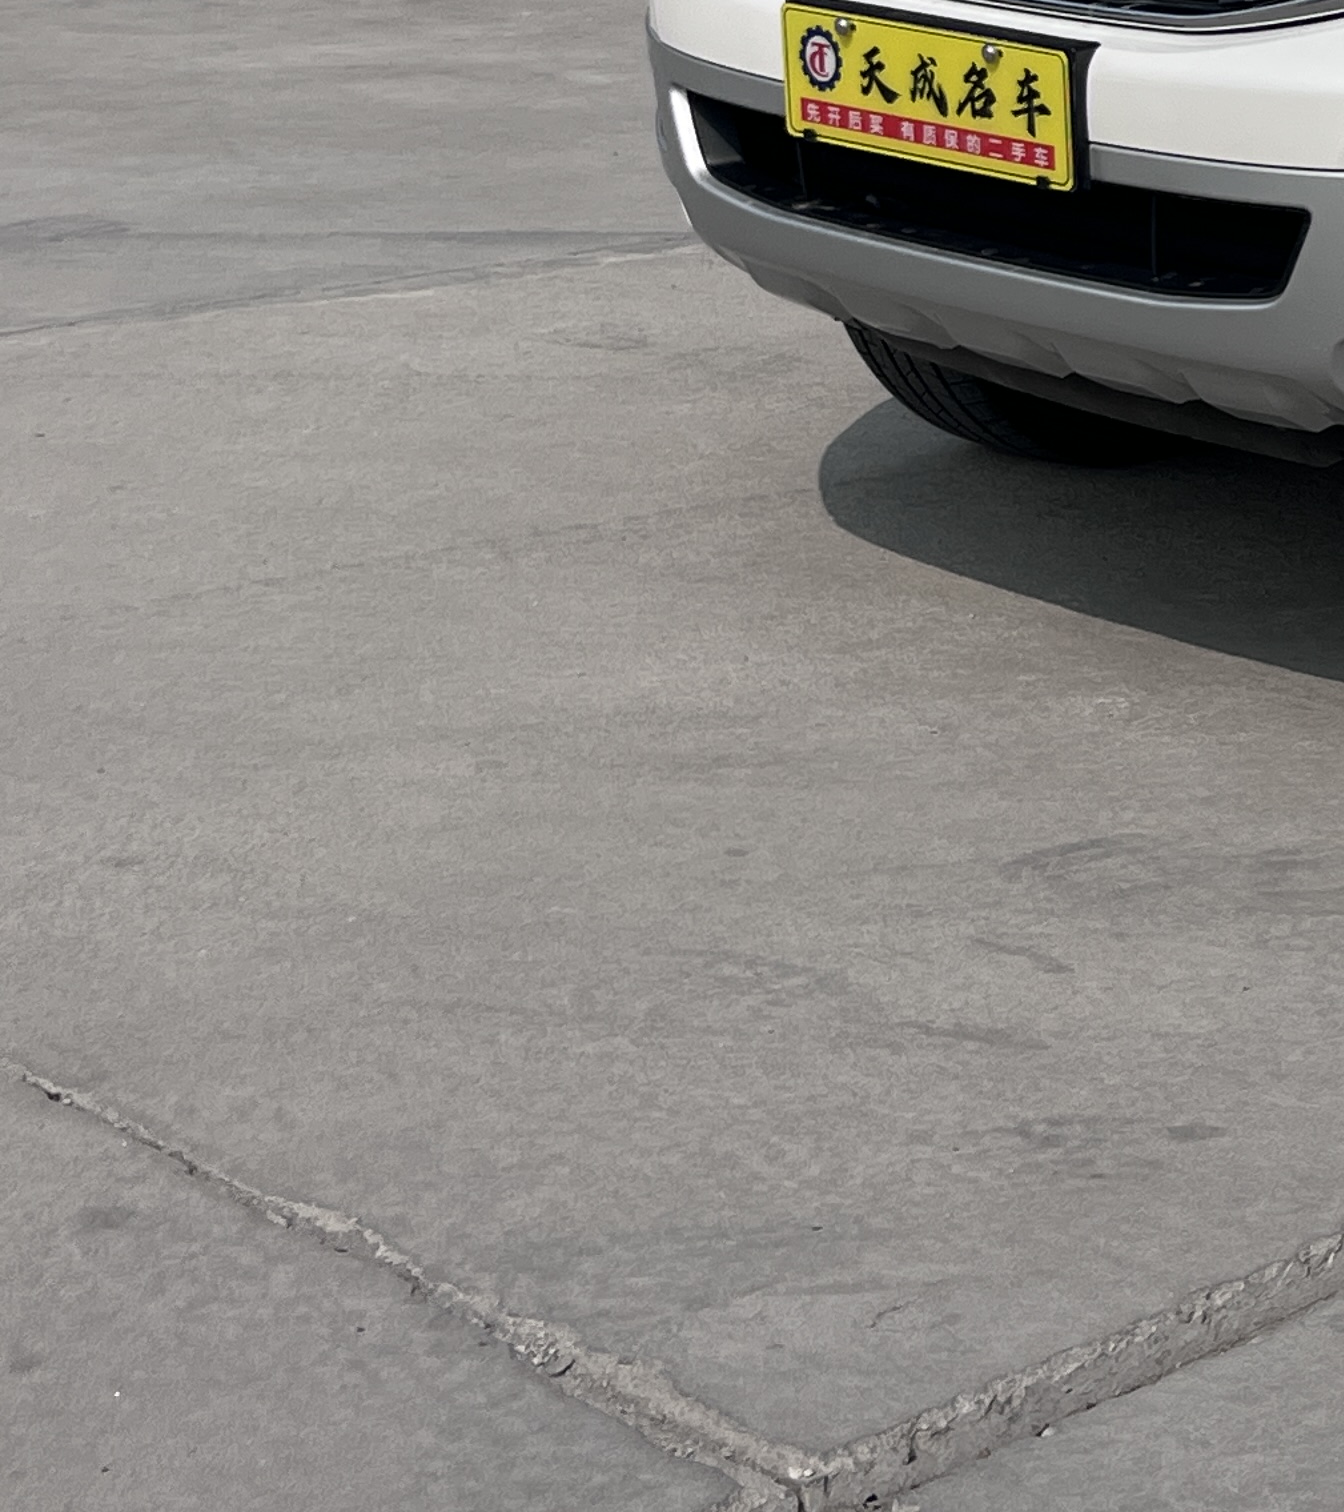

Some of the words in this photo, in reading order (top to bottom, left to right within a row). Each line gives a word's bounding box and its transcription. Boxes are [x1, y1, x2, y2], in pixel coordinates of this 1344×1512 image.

[859, 45, 1052, 138] 天成名车
[805, 102, 885, 136] 先开后买
[901, 120, 1051, 168] 有质保的二手车
